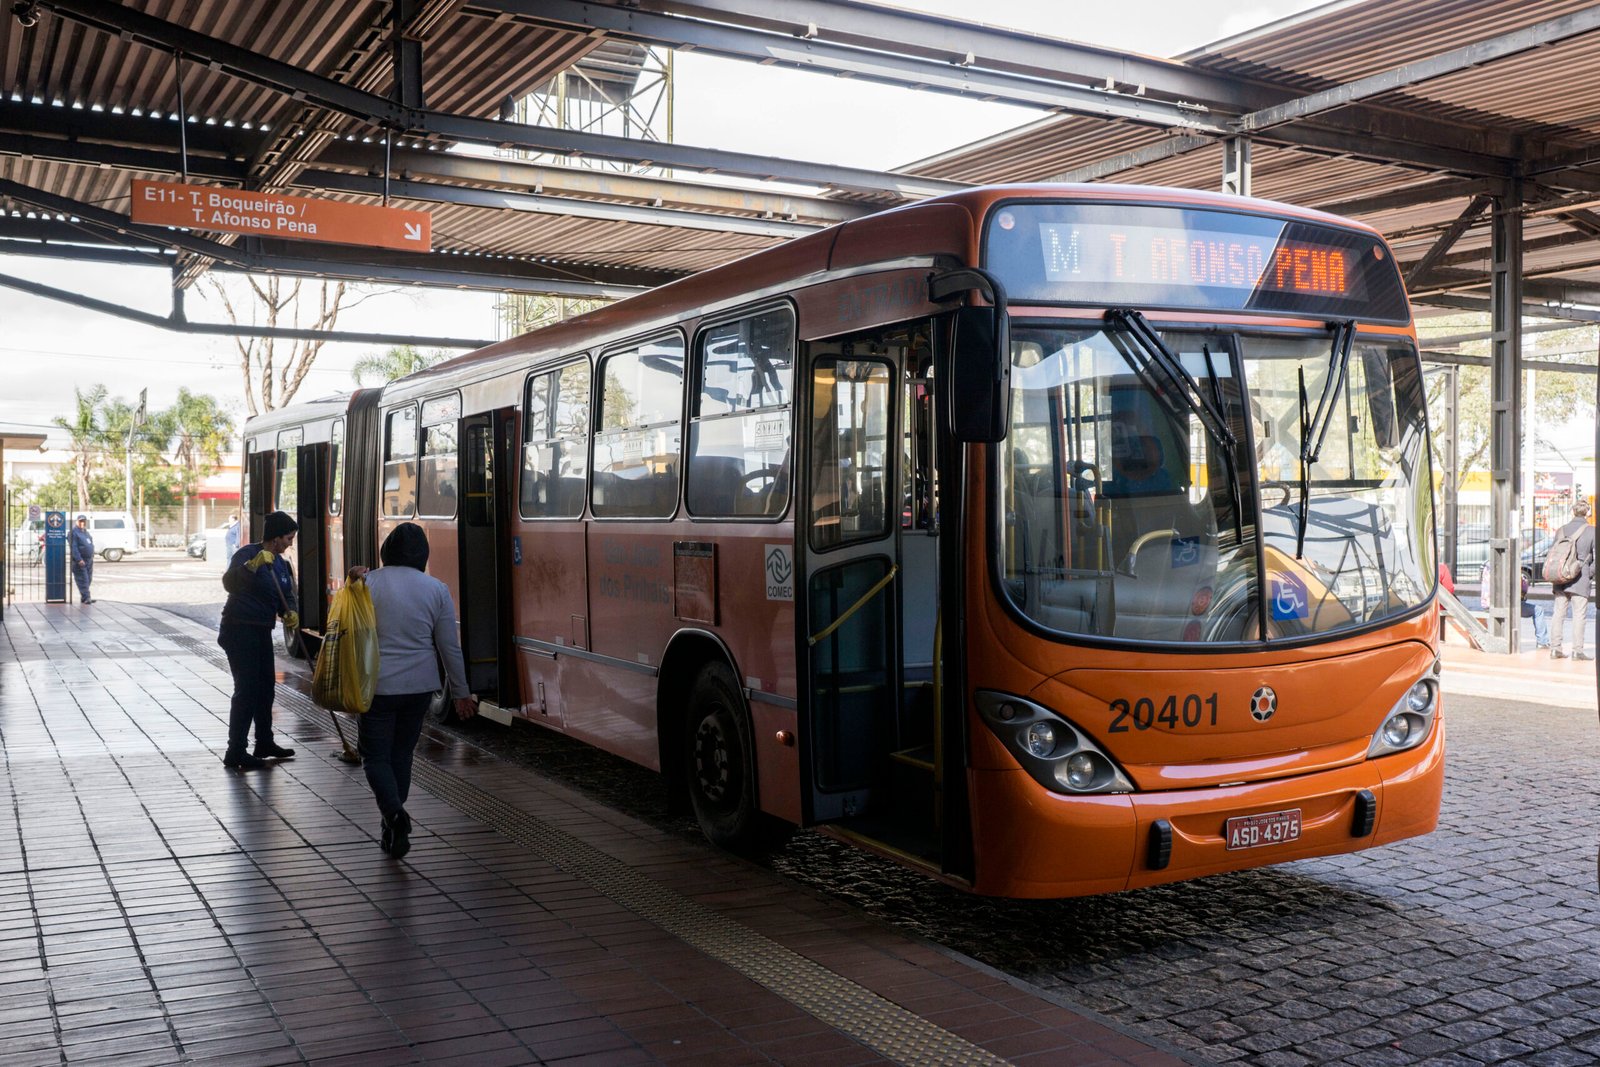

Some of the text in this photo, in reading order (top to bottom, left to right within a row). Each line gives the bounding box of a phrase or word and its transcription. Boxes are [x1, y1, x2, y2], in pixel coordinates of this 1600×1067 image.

[189, 191, 203, 206] T.
[208, 193, 295, 216] Boqueirão
[192, 208, 318, 235] T. Afonso Pena
[1049, 228, 1081, 273] M
[1151, 237, 1263, 286] AFONSO
[1276, 246, 1345, 292] PENA
[767, 585, 793, 598] COMEC
[1107, 692, 1218, 733] 20401
